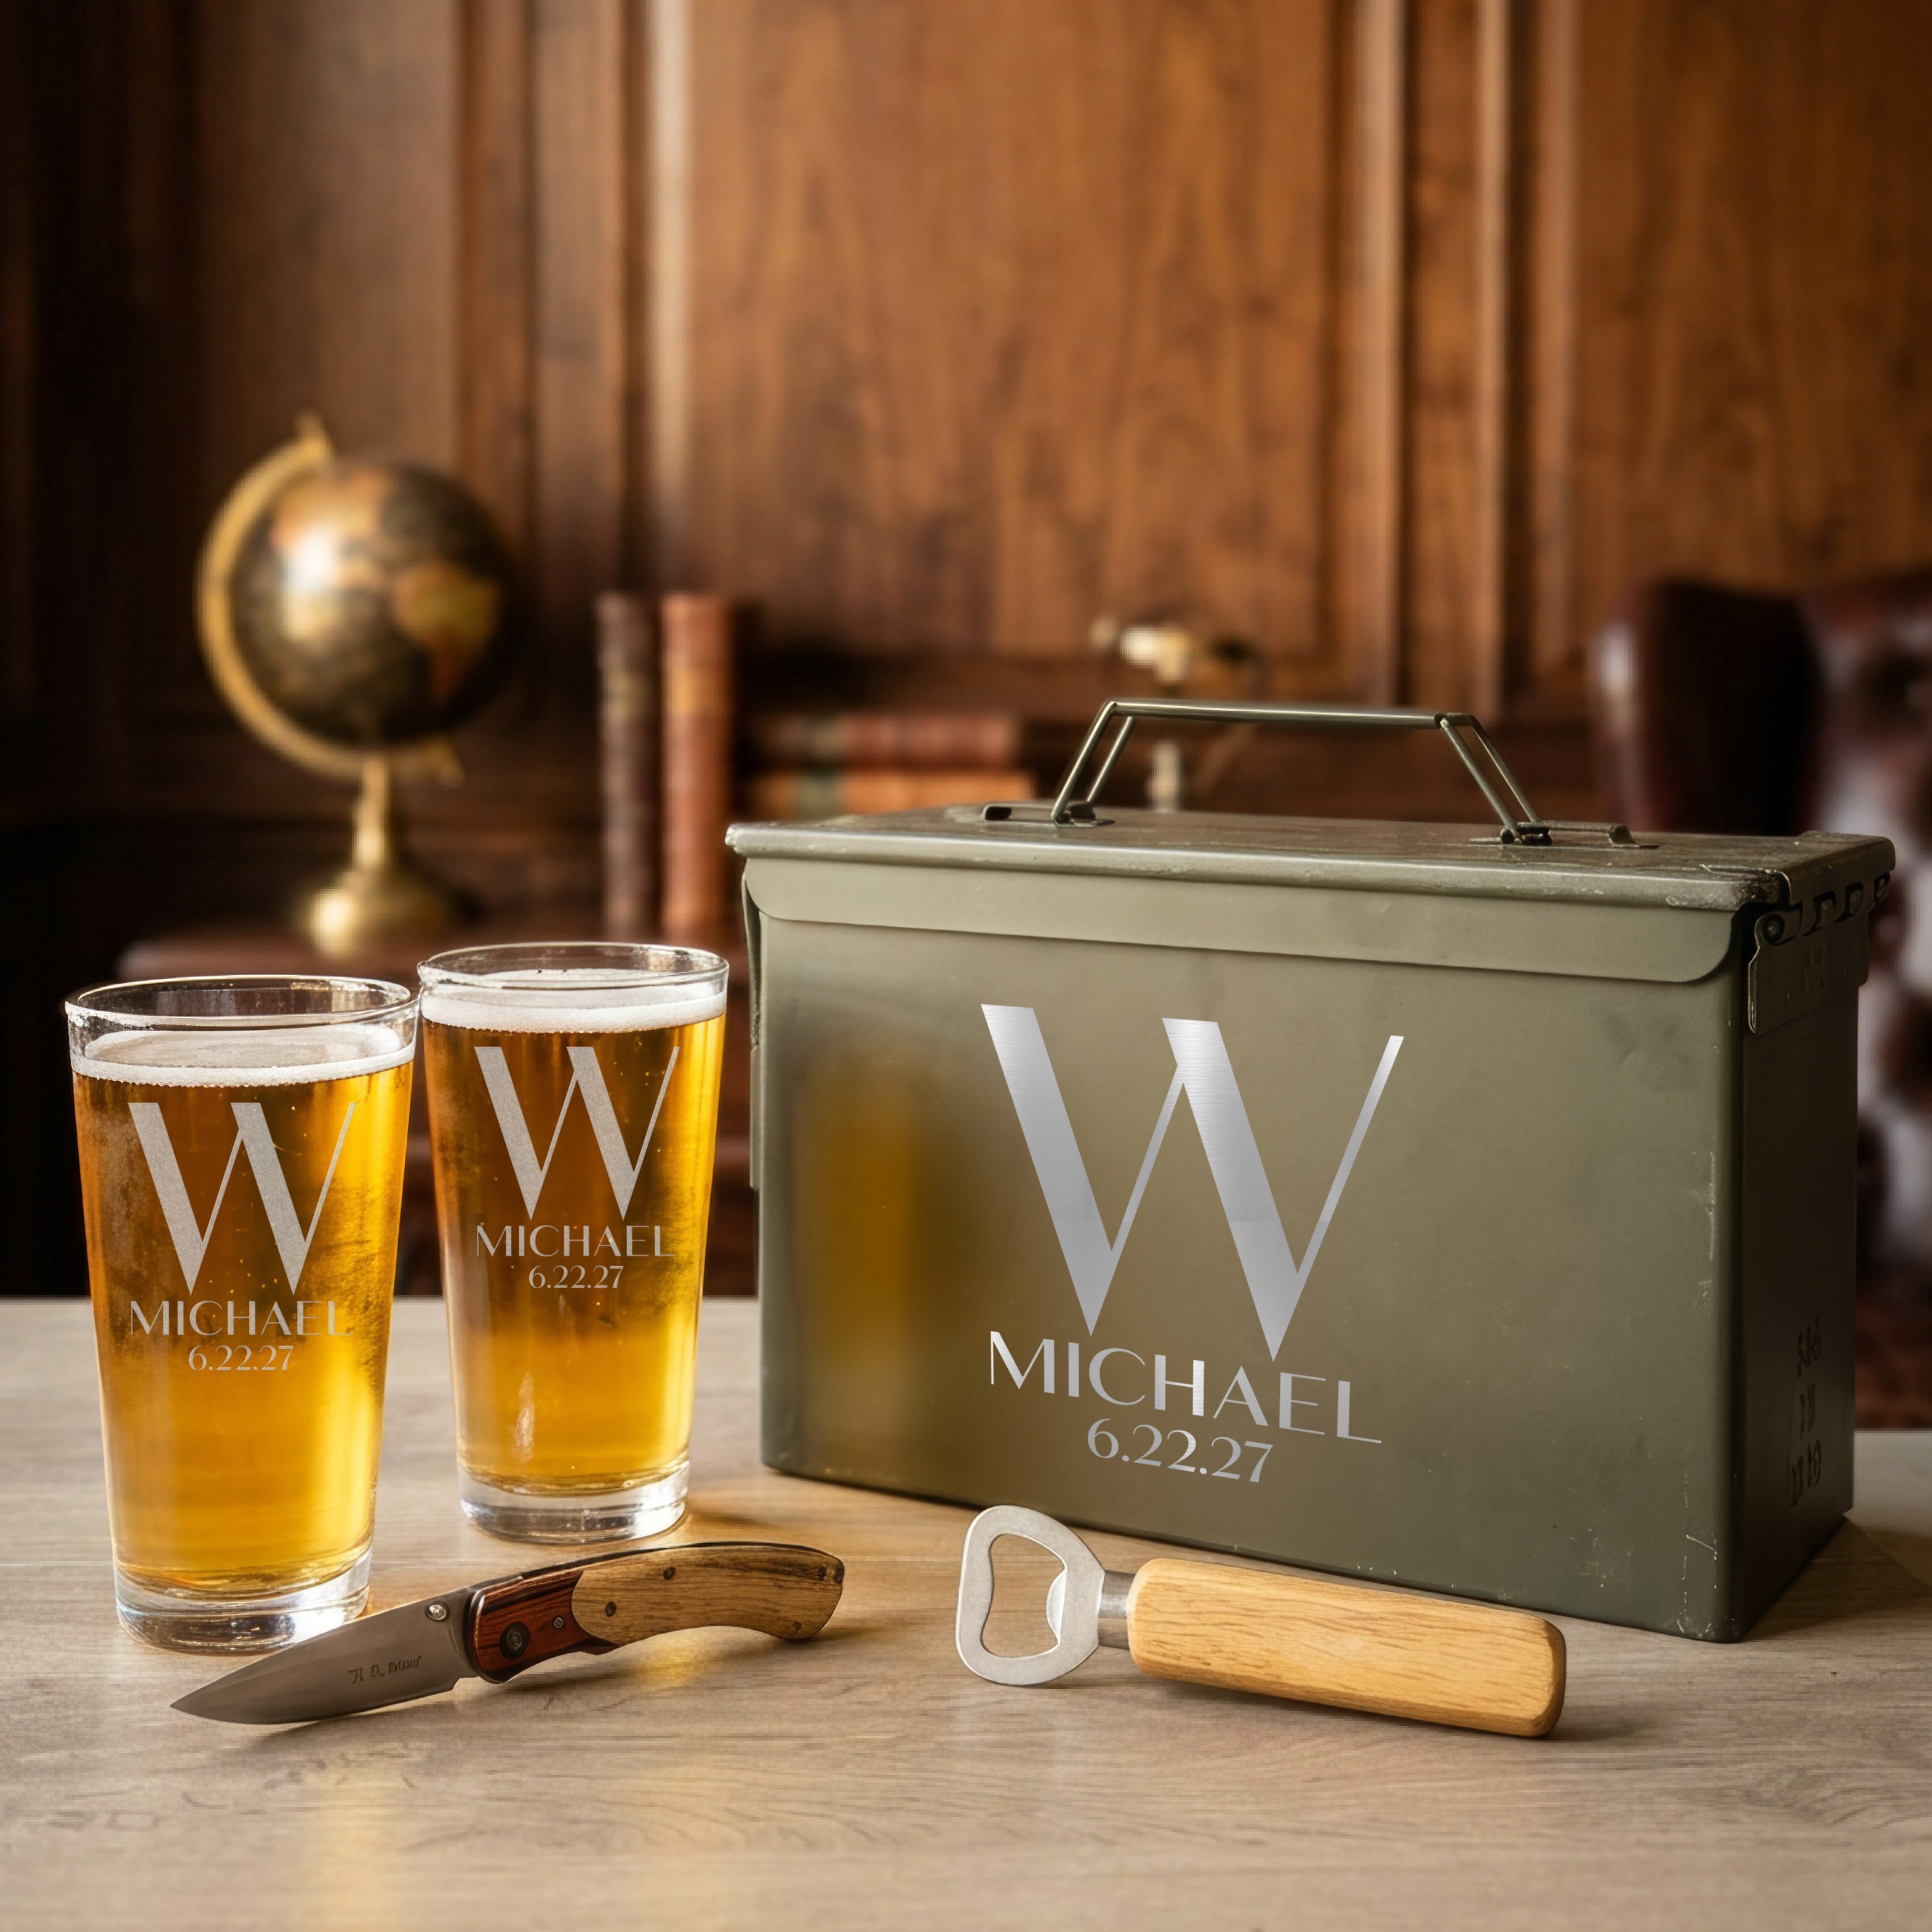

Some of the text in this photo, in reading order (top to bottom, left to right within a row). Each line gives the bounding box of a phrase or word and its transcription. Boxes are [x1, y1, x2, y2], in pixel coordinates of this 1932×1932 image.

[474, 1046, 681, 1221] W
[127, 1102, 357, 1295] W
[981, 1003, 1403, 1361] W
[476, 1224, 676, 1257] MICHAEL
[529, 1265, 624, 1289] 6.22.27
[129, 1301, 351, 1336] MICHAEL
[188, 1345, 293, 1371] 6.22.27
[989, 1330, 1383, 1445] MICHAEL
[1086, 1418, 1272, 1483] 6.22.27
